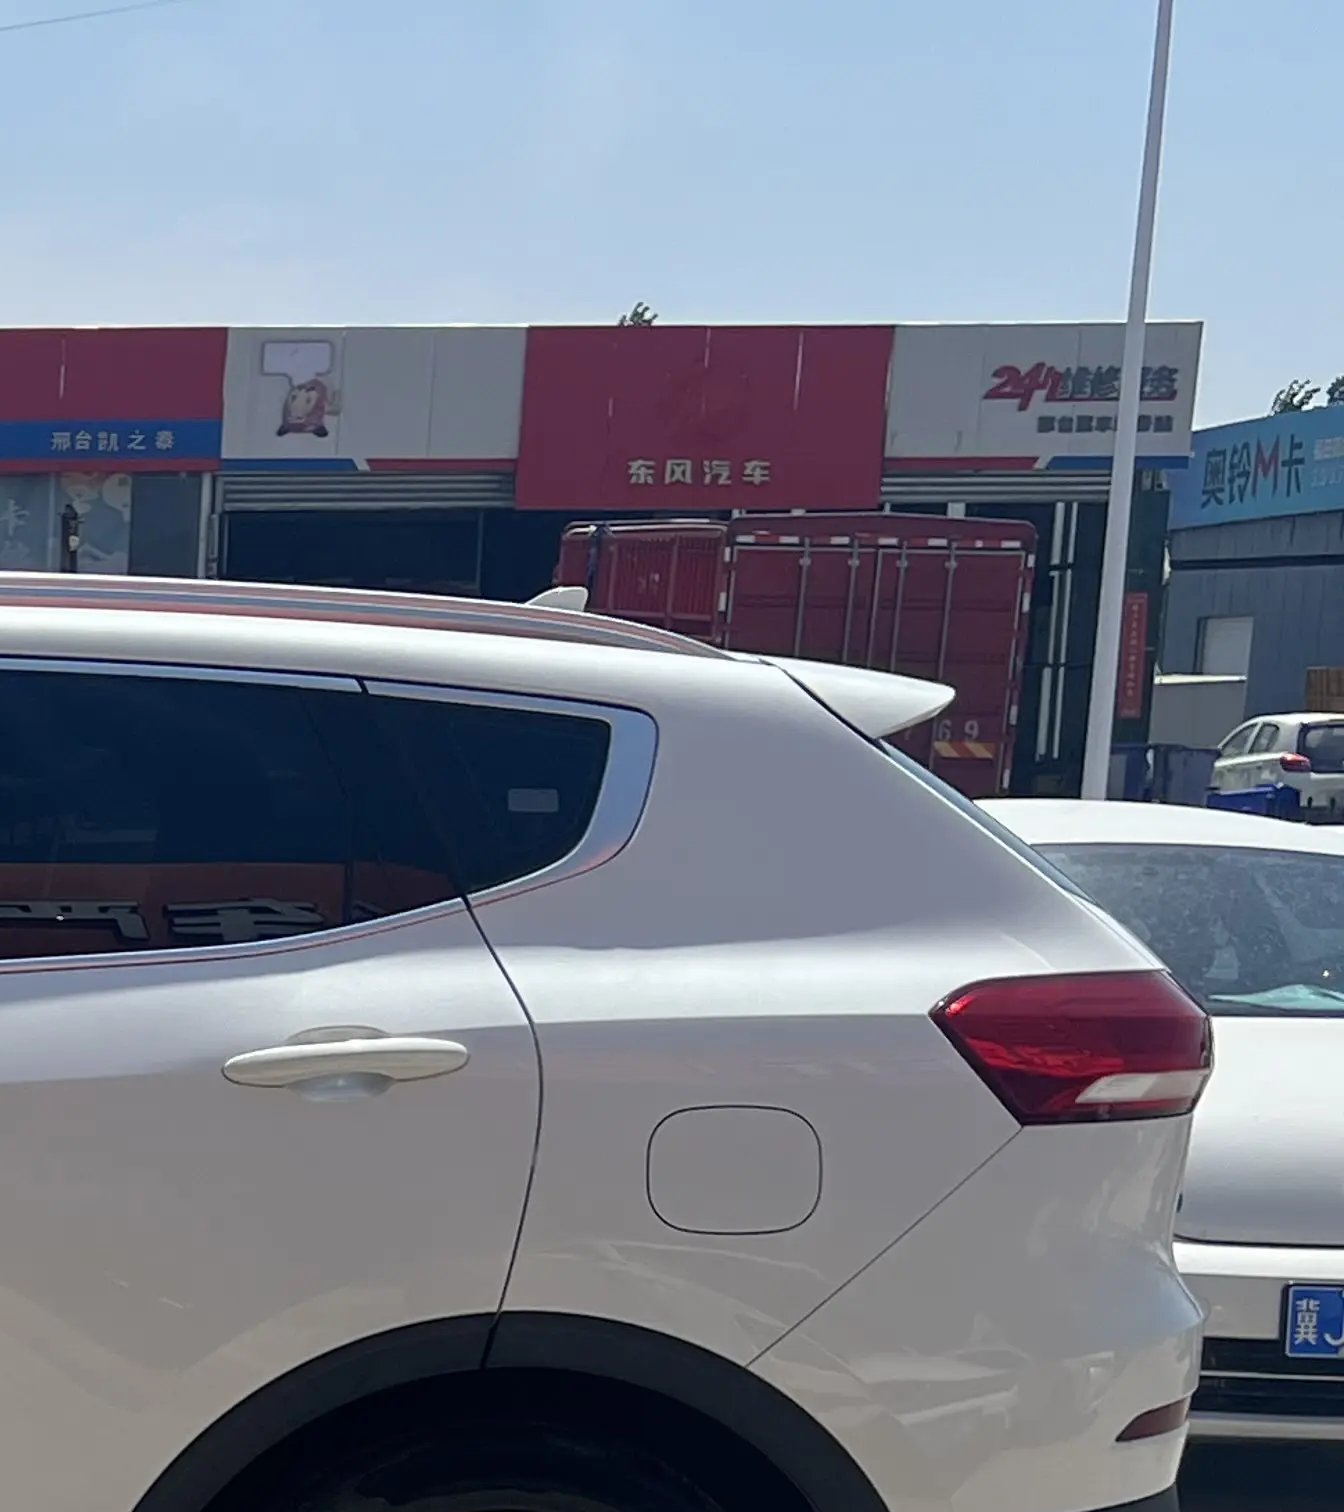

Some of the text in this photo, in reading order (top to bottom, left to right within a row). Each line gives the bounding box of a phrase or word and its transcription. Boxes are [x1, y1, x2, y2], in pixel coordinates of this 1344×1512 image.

[627, 458, 772, 486] 东风汽车
[1200, 433, 1306, 509] 奥铃M卡
